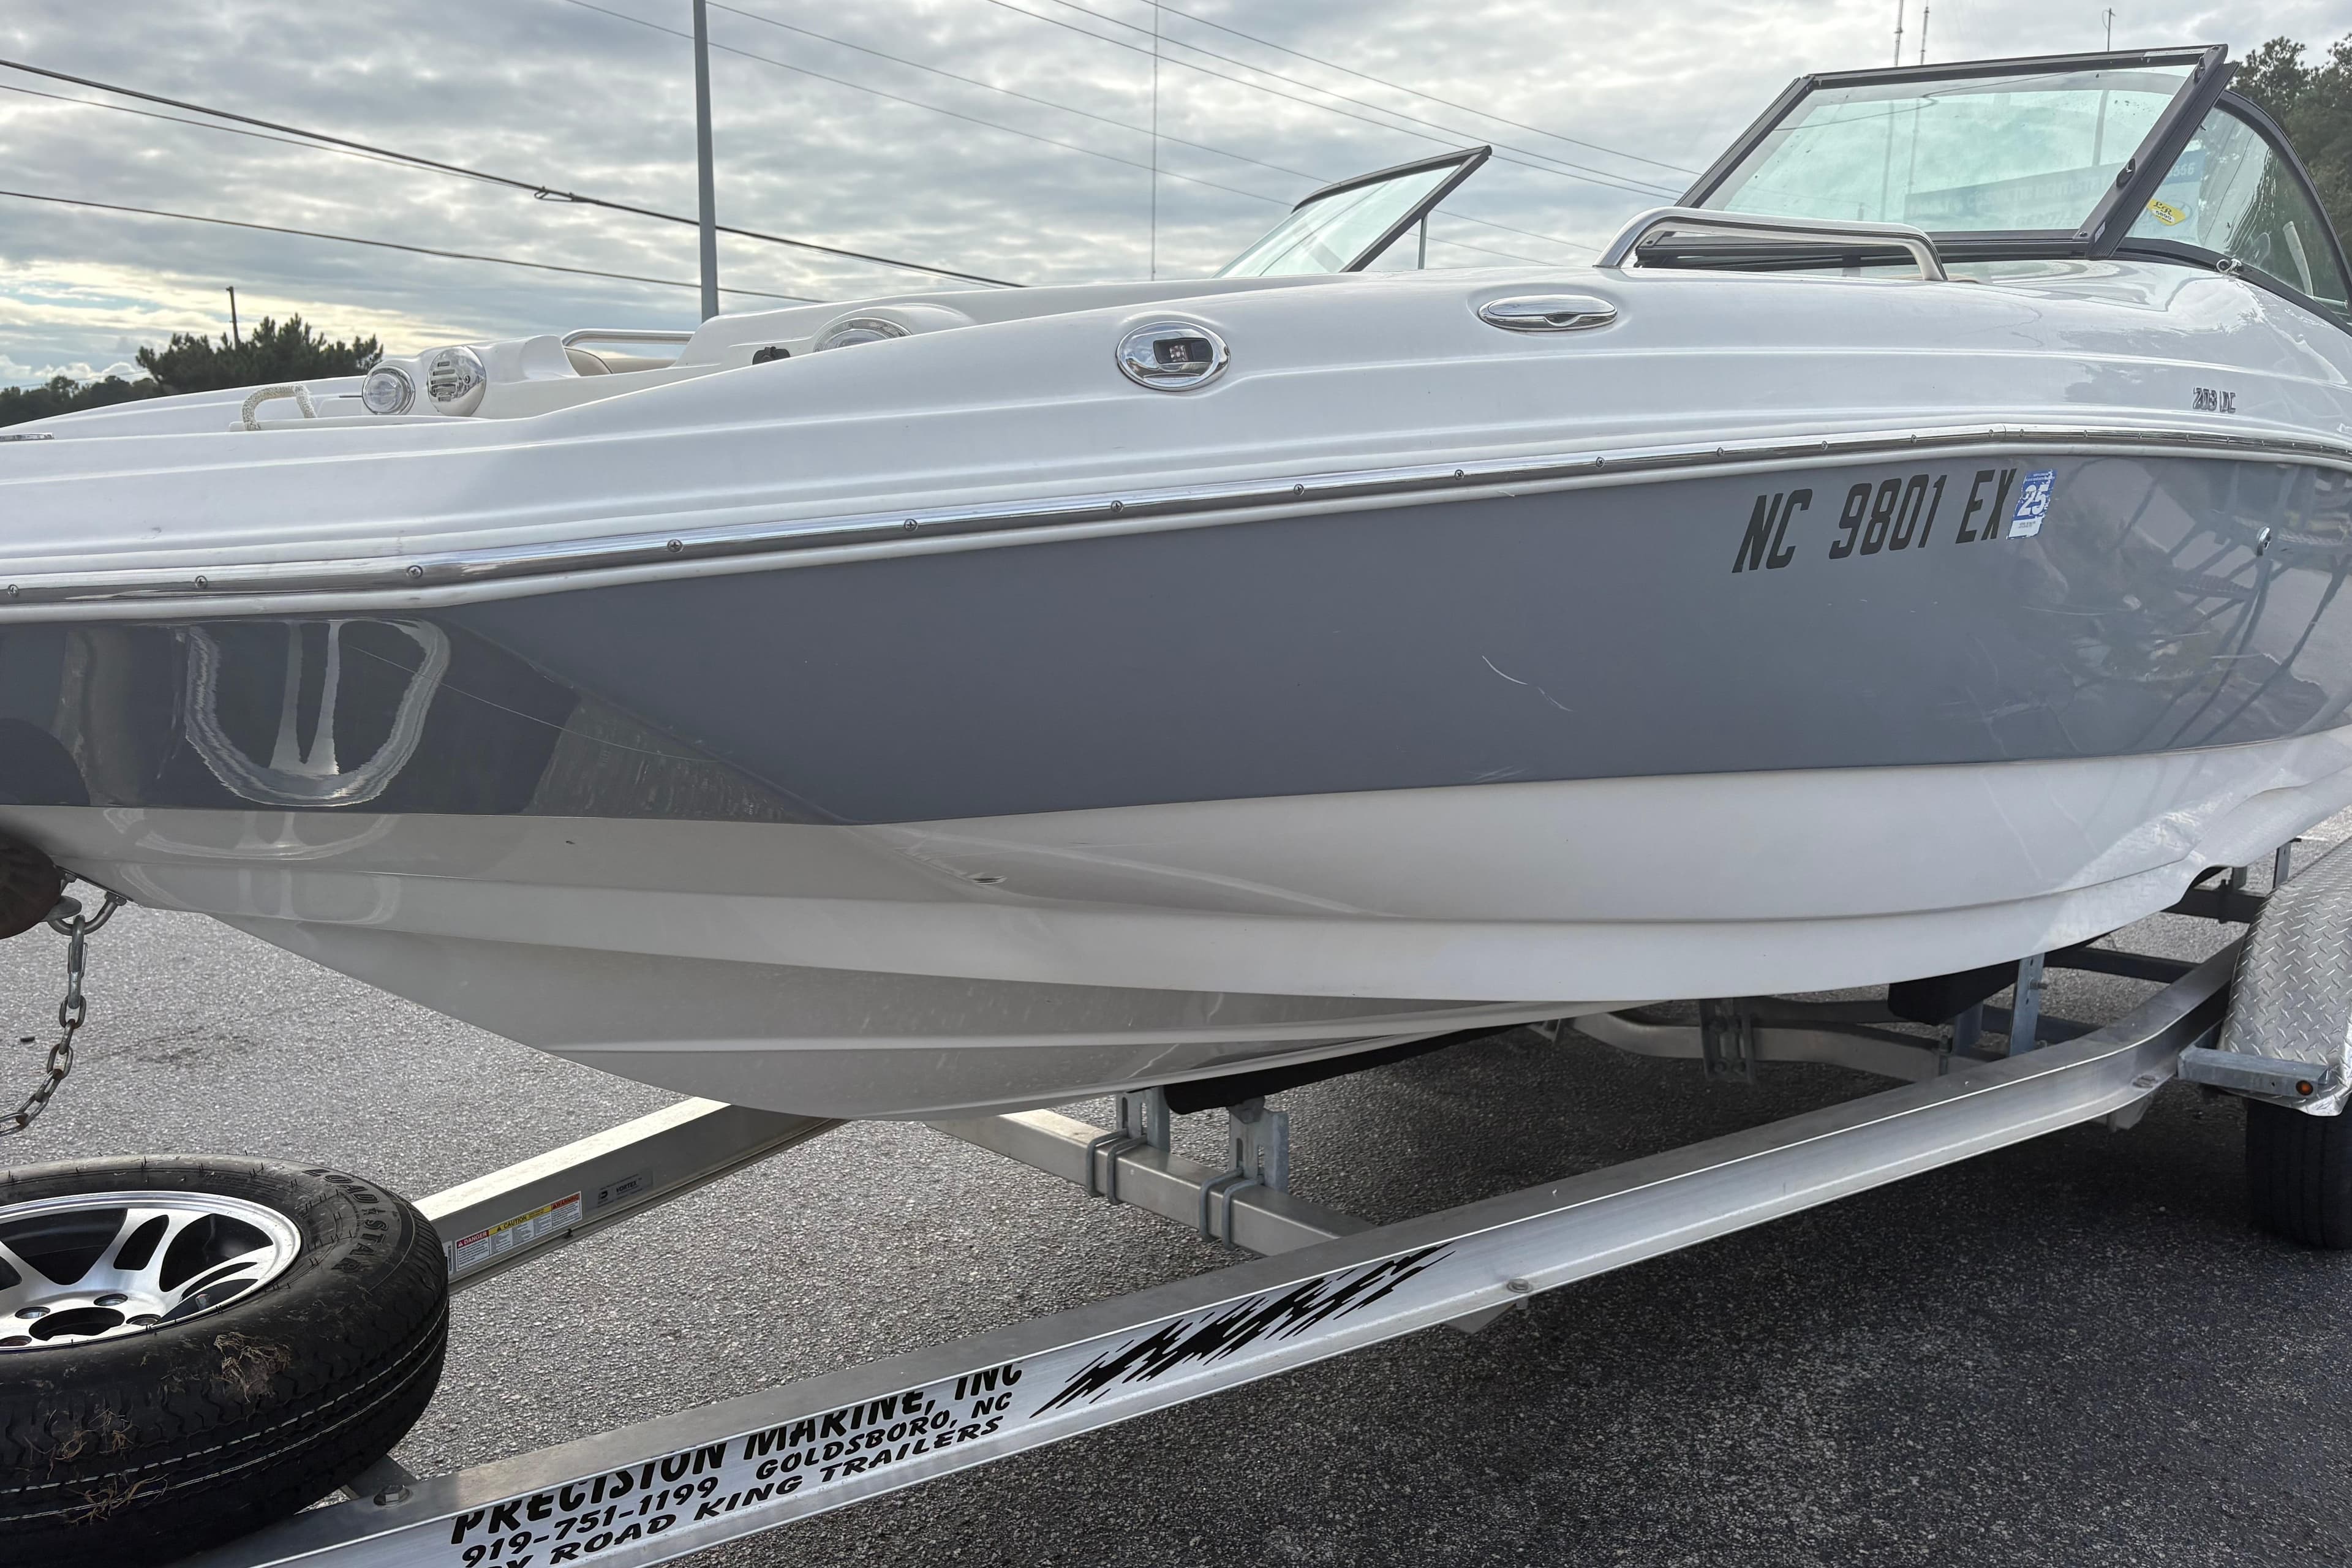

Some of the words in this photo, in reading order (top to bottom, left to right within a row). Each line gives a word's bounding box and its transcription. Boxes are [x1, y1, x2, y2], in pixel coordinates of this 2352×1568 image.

[1732, 488, 1813, 573] NC
[1828, 474, 1948, 560] 9801
[1955, 468, 2017, 545] EX
[2016, 484, 2049, 517] 25
[301, 1169, 380, 1204] LOAD
[331, 1219, 389, 1273] STAR
[463, 1231, 488, 1245] DANGER
[503, 1215, 527, 1229] CAUTION
[450, 1441, 728, 1545] PRECISION
[743, 1391, 936, 1460] MARINE,
[954, 1362, 1023, 1401] INC
[462, 1477, 718, 1568] 919-751-1199
[756, 1409, 957, 1480] GOLDSBORO,
[971, 1392, 1012, 1419] NC
[549, 1514, 677, 1565] ROAD
[693, 1475, 803, 1521] KING
[820, 1416, 1003, 1483] TRAILERS
